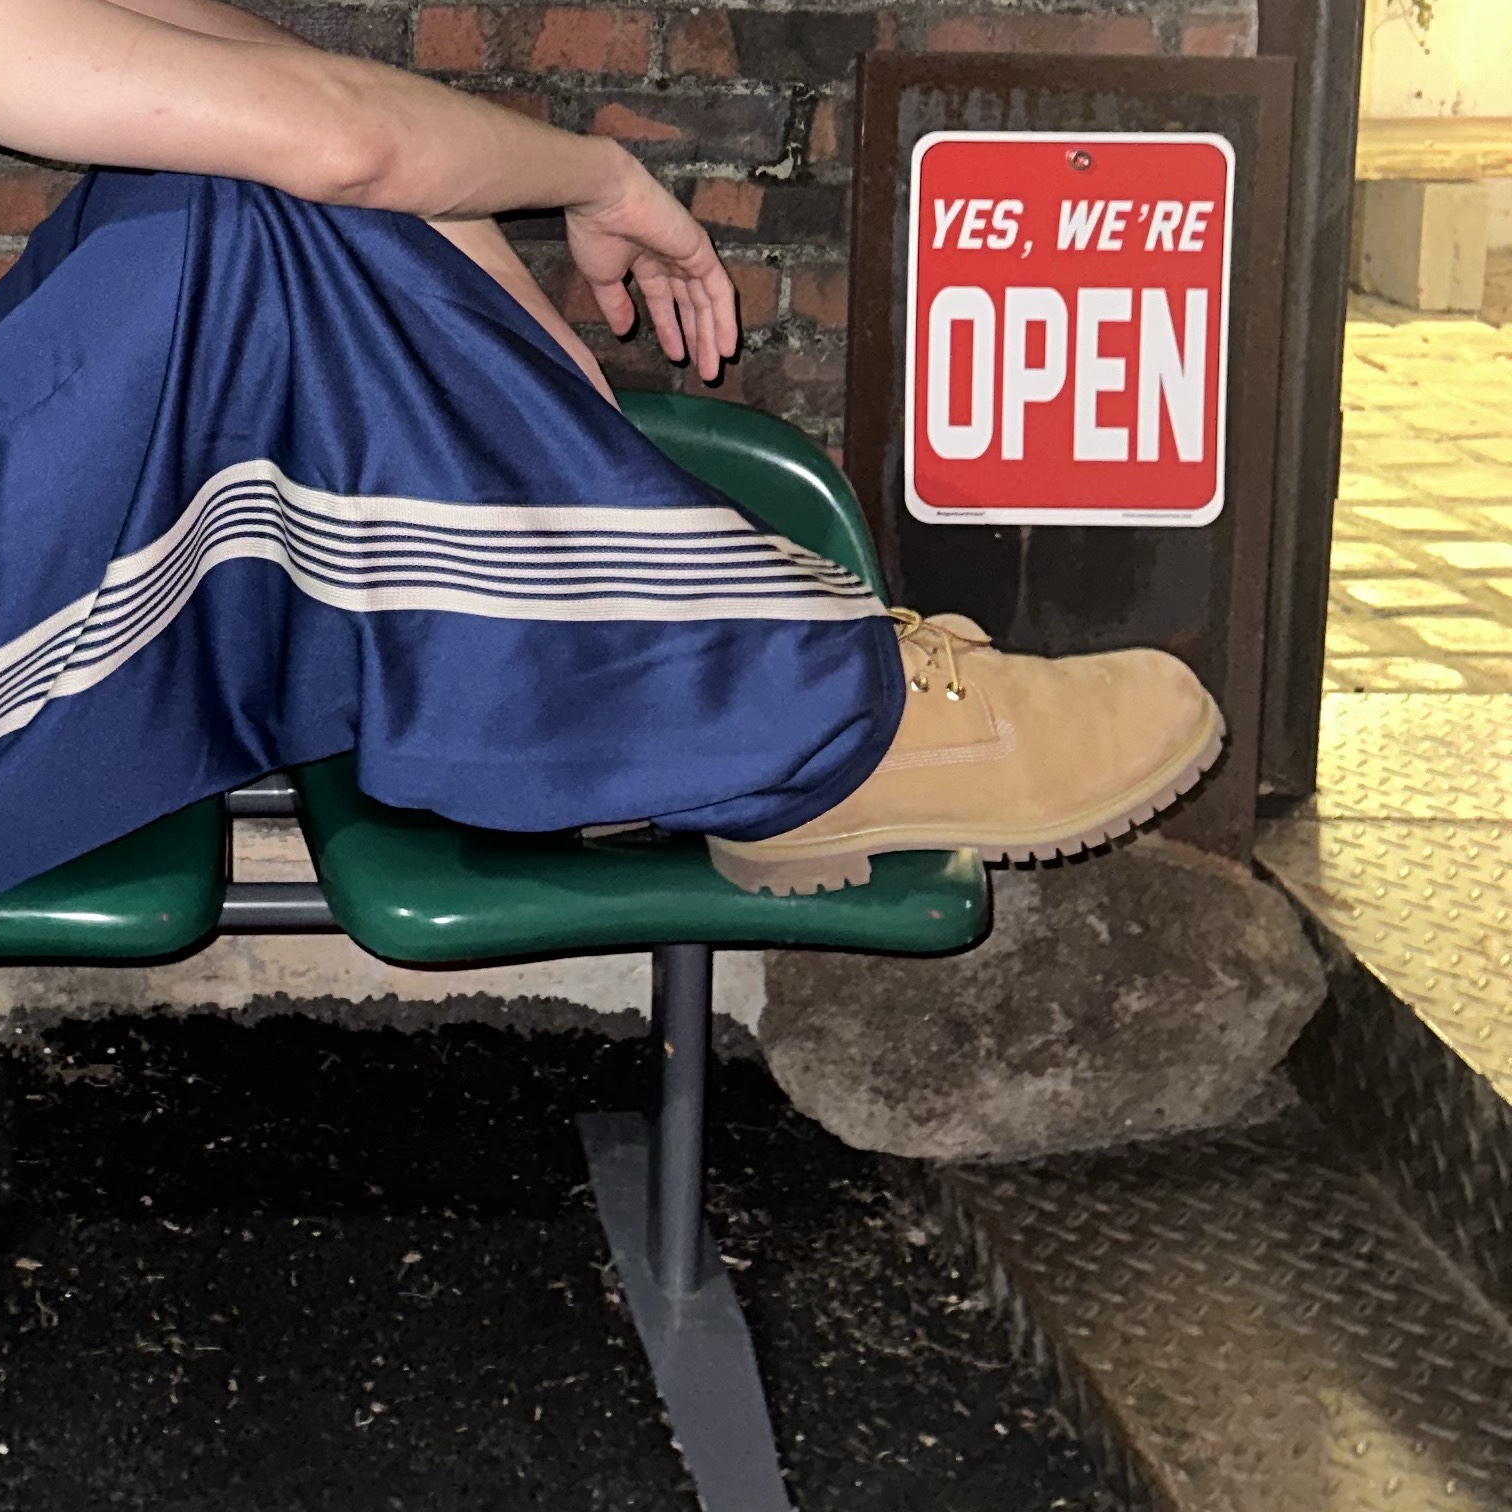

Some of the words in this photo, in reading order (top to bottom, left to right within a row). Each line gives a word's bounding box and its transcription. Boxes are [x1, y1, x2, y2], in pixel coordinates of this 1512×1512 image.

[932, 199, 1033, 259] YES,
[1057, 199, 1214, 251] WE'RE
[927, 286, 1208, 462] OPEN
